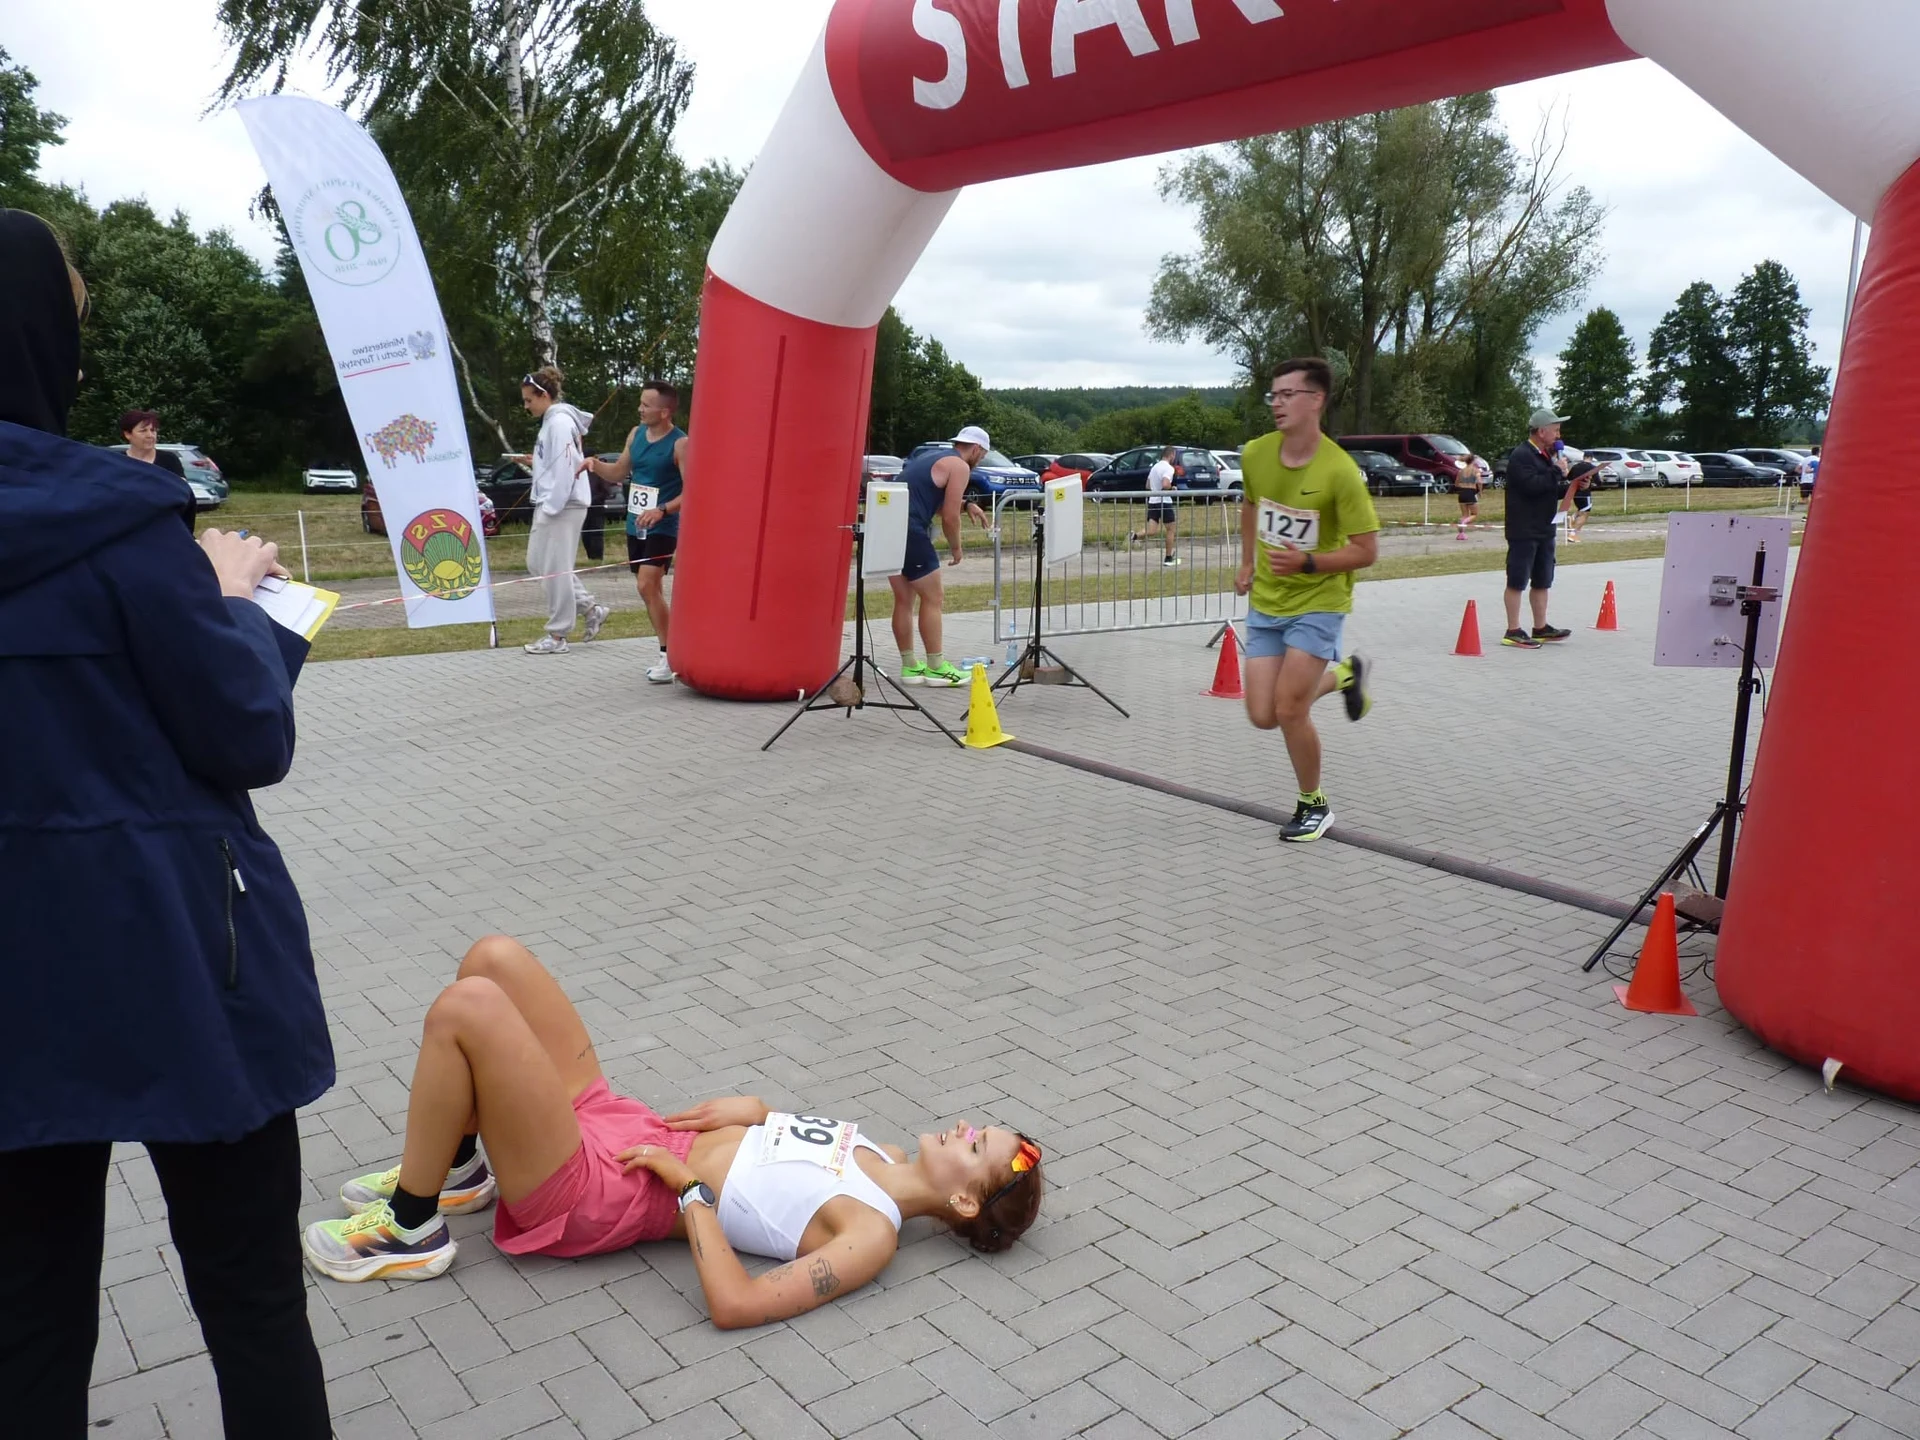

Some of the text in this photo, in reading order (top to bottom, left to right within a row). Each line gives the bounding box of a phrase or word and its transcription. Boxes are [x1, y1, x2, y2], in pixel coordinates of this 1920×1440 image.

[912, 0, 1340, 109] STA
[632, 490, 648, 507] 63
[1265, 511, 1313, 539] 127
